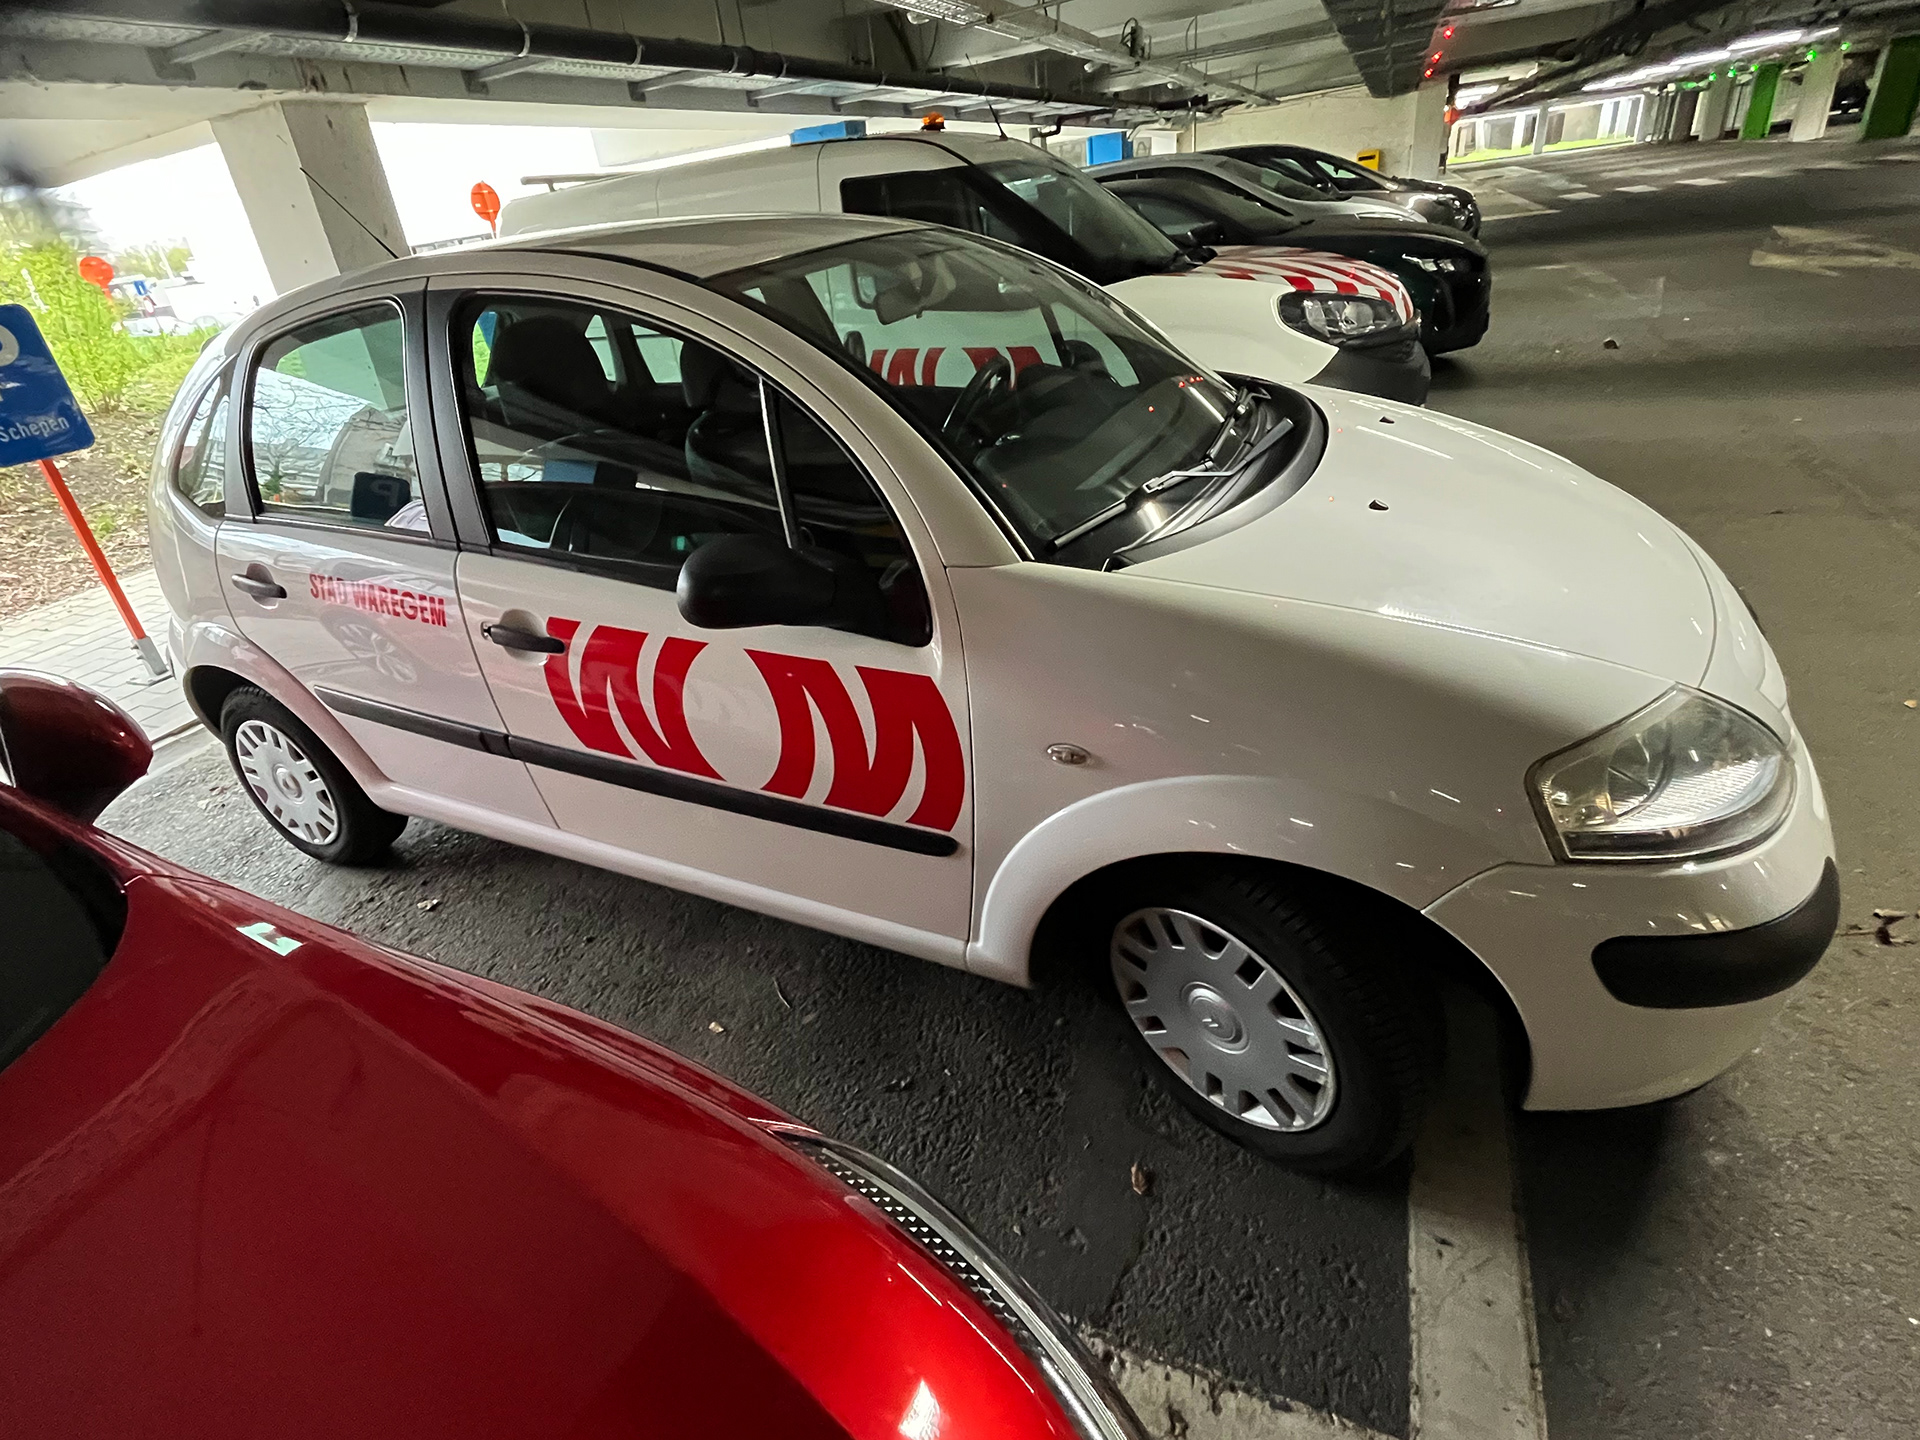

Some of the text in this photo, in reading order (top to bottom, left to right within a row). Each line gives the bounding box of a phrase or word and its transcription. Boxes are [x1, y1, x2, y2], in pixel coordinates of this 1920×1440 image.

[0, 416, 70, 442] Schepen
[309, 573, 447, 627] STAD WAREGEM
